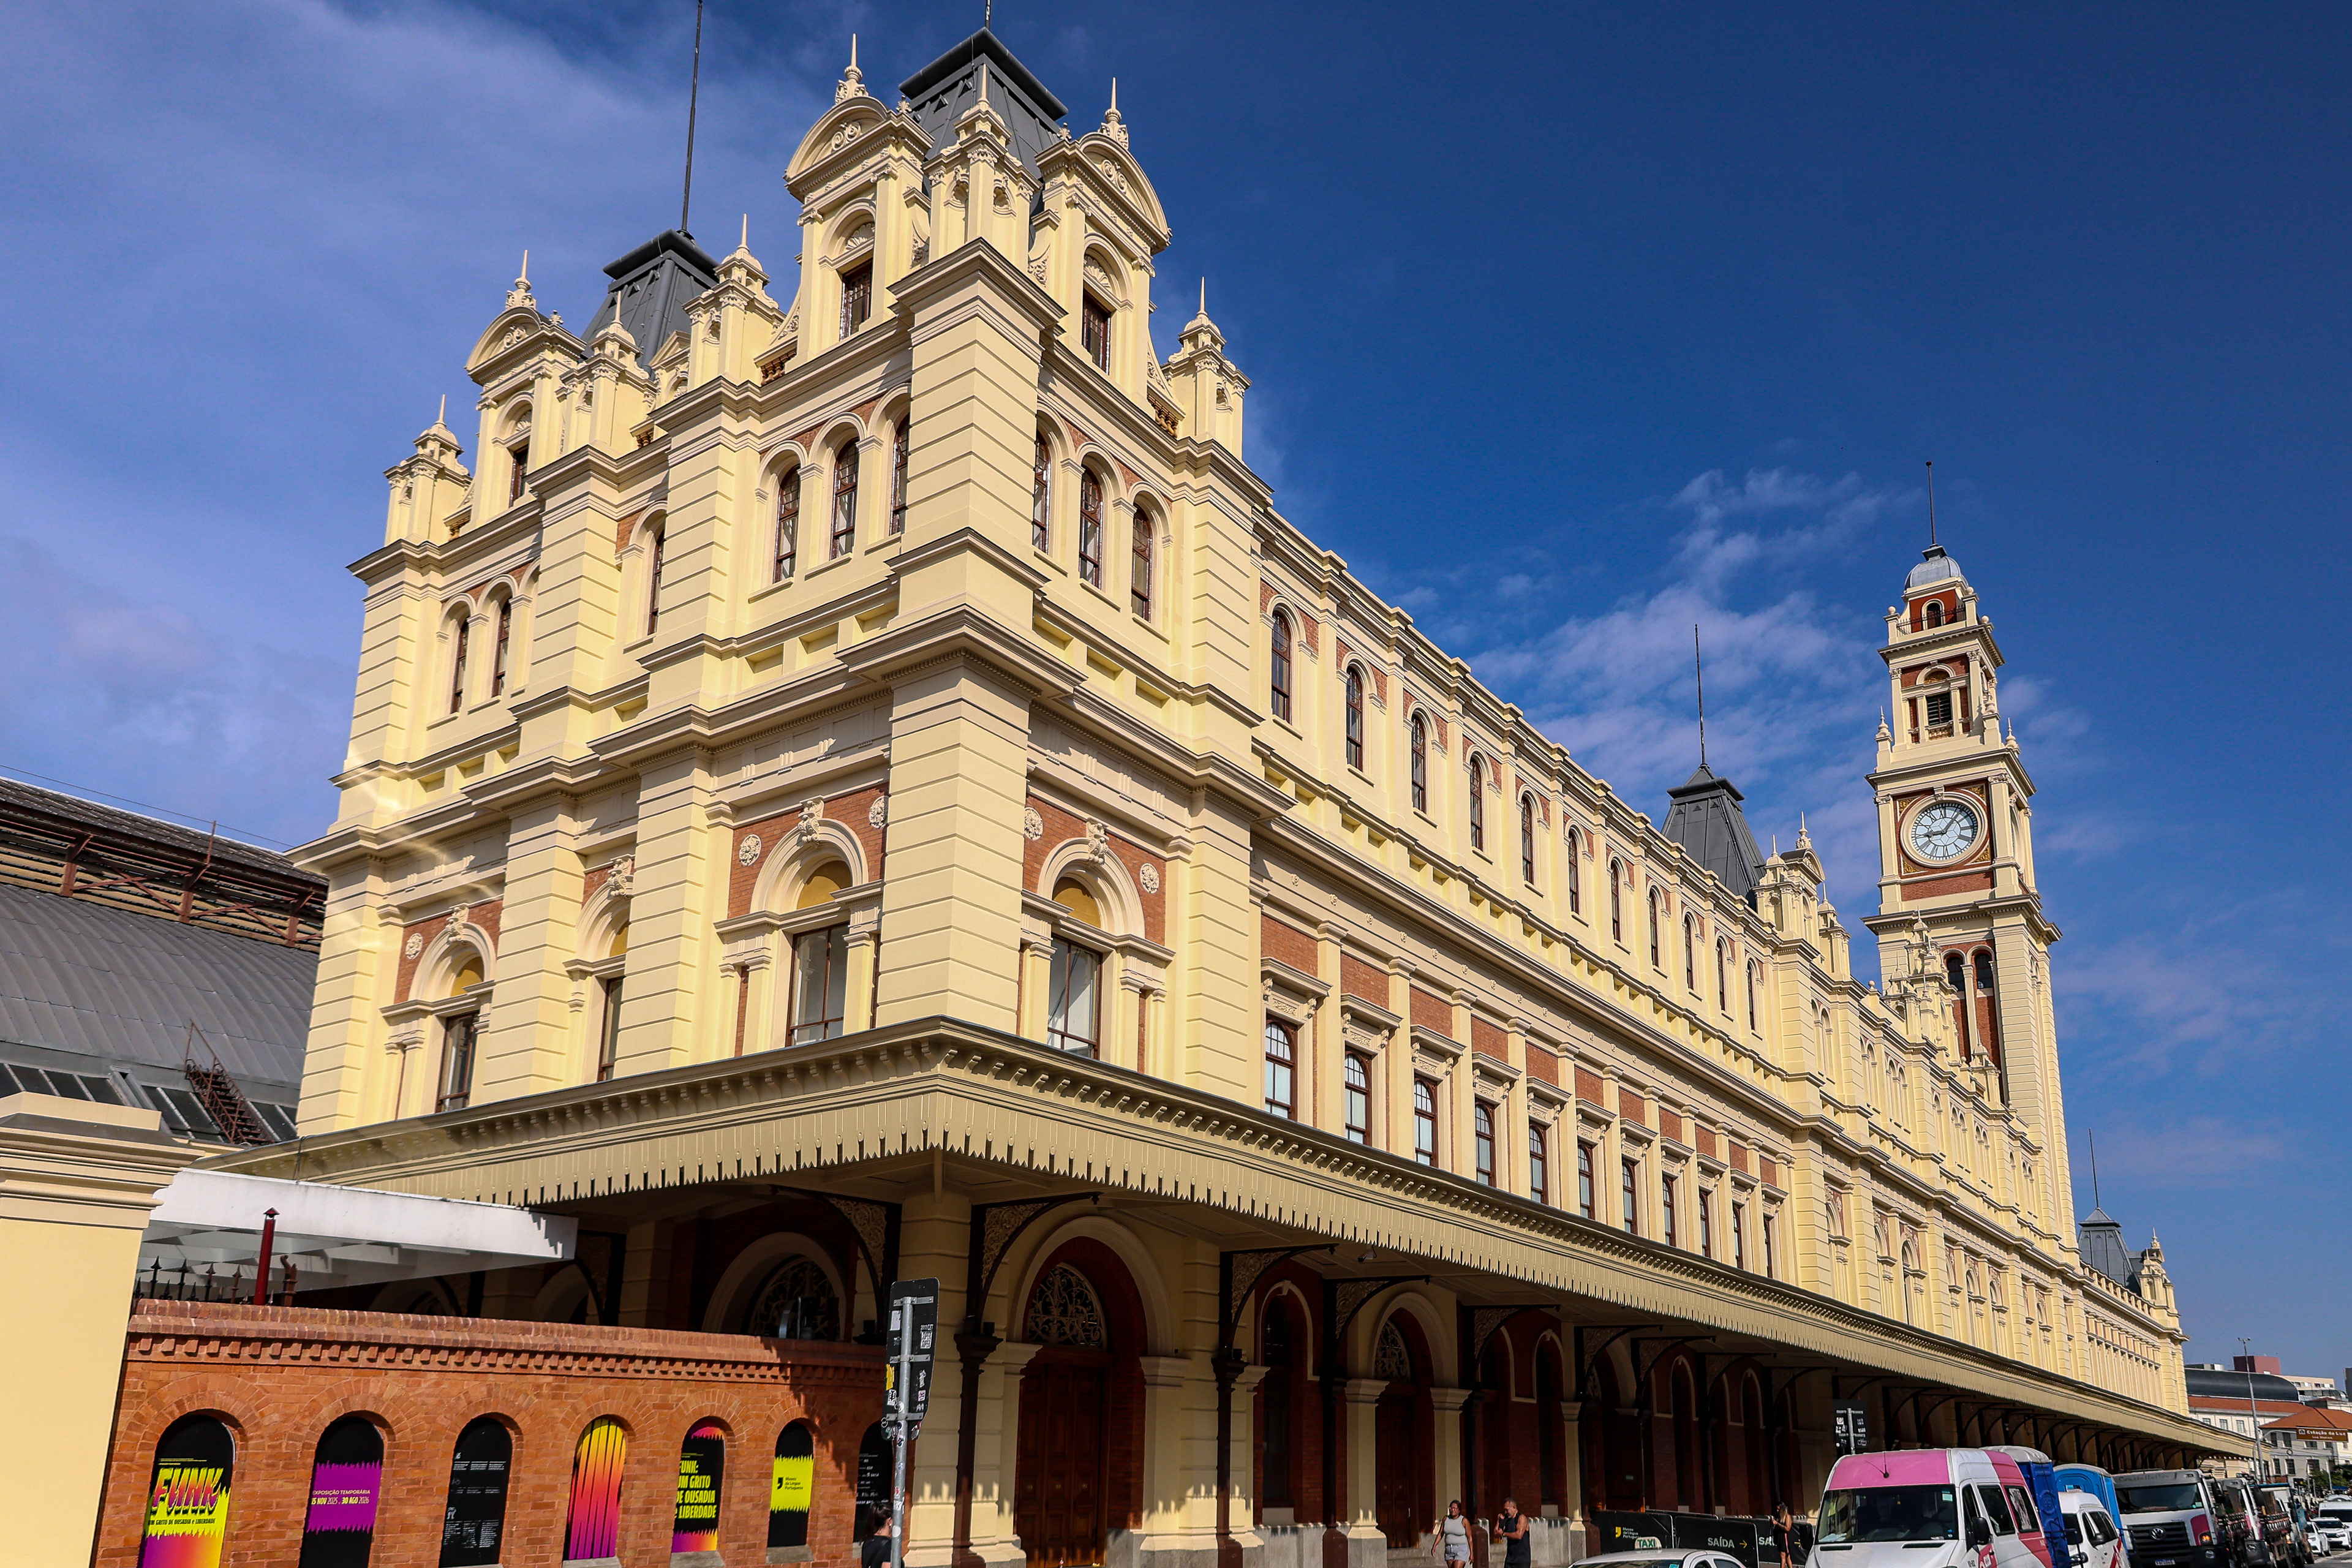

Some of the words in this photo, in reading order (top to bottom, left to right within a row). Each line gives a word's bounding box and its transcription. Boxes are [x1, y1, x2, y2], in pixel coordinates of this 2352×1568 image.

[690, 1475, 711, 1488] GRITO
[151, 1467, 224, 1515] FUNK
[685, 1490, 715, 1503] OUSADIA
[679, 1505, 717, 1518] LIBERDADE
[1637, 1538, 1656, 1548] TAXI
[1707, 1536, 1735, 1548] SAÍDA
